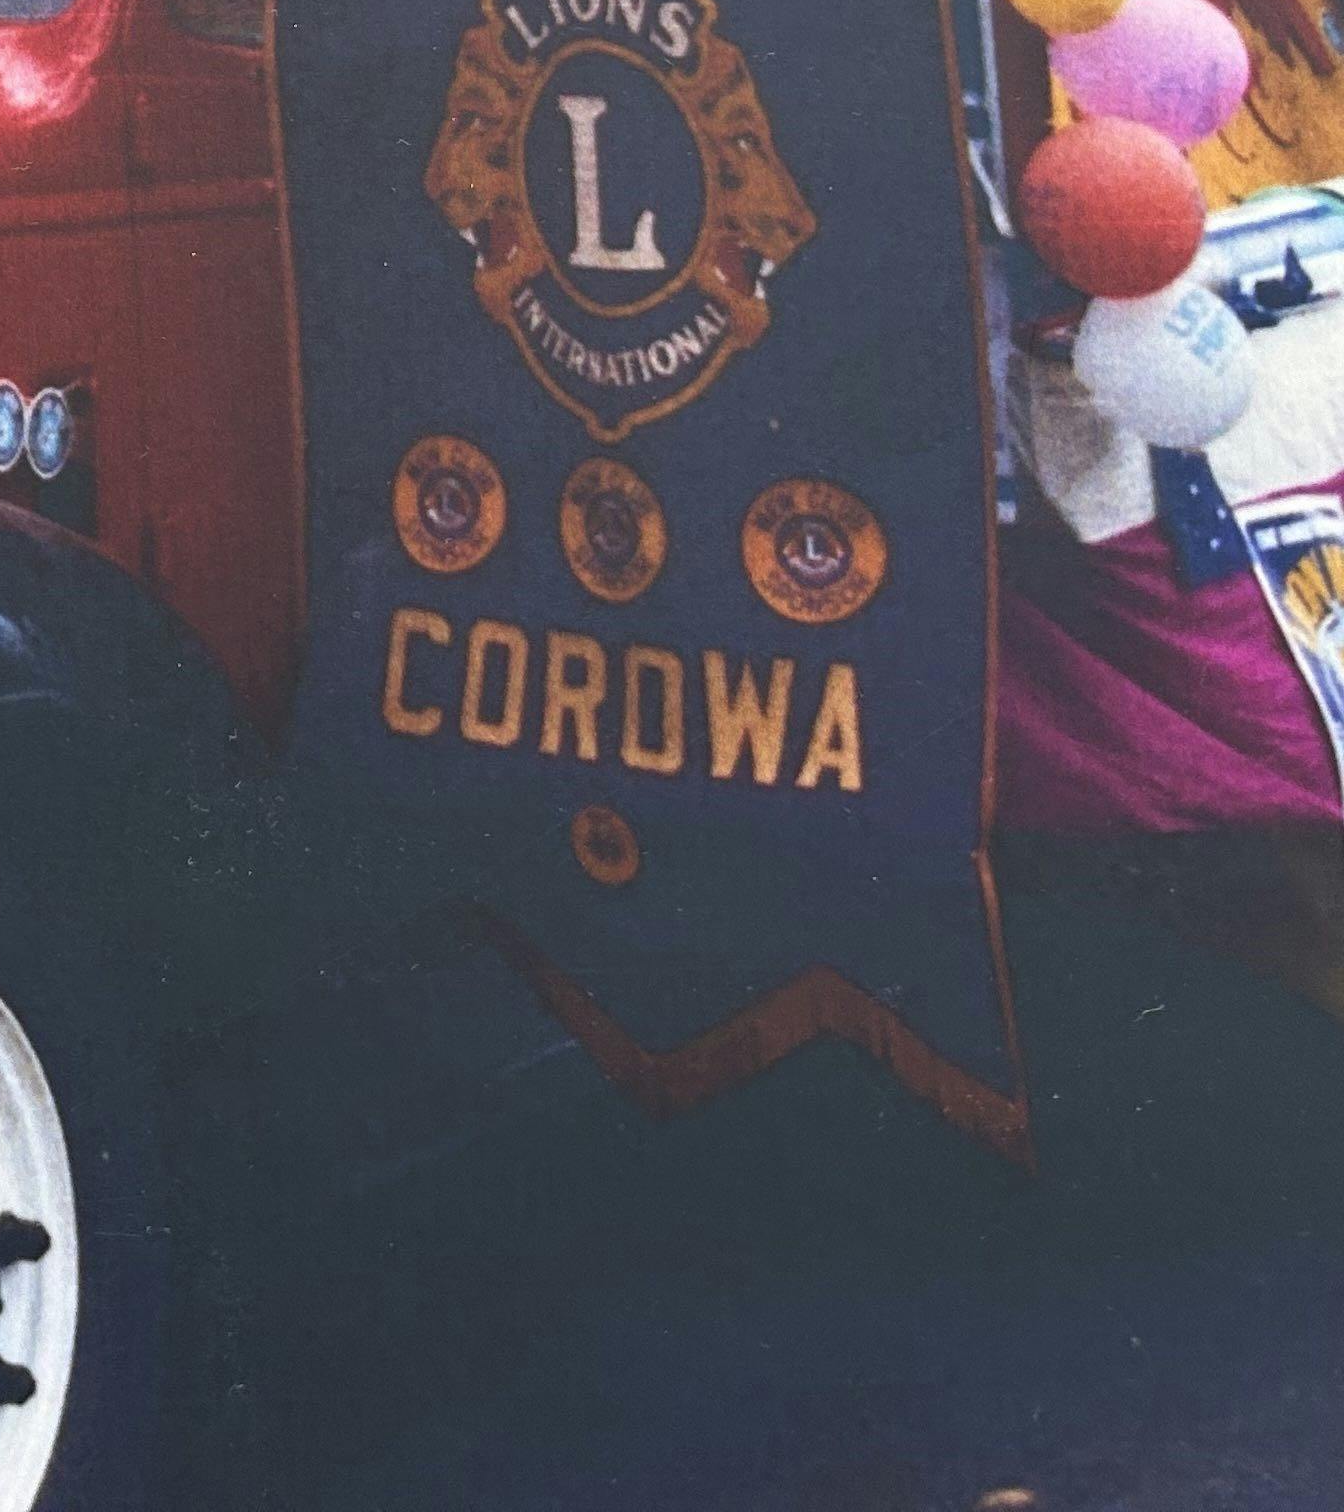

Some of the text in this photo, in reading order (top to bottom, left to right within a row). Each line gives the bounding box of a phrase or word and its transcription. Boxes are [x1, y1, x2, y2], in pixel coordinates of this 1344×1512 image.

[558, 95, 666, 271] L
[513, 288, 728, 387] INTERNATIONAL
[382, 607, 862, 792] COROWA
